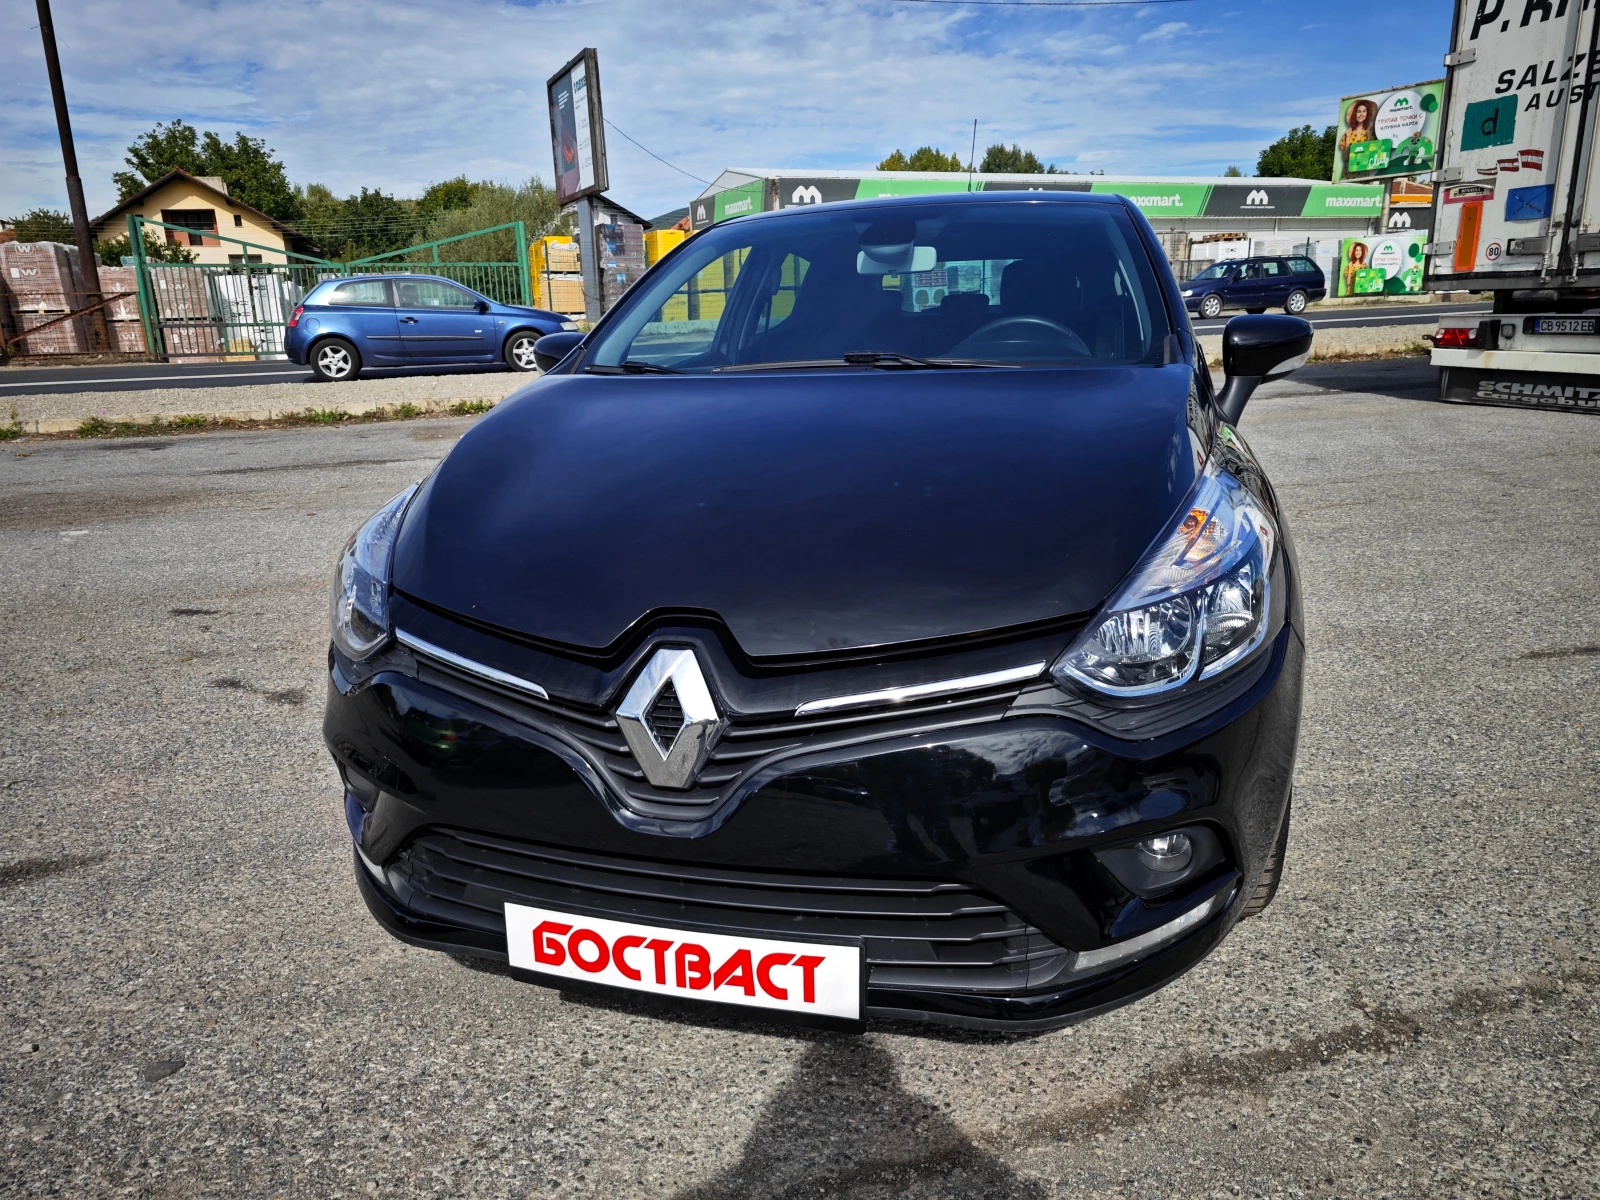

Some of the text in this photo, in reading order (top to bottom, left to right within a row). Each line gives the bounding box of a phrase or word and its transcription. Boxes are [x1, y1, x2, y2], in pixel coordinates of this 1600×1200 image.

[1481, 108, 1499, 136] d
[1129, 193, 1184, 207] axxmart.
[1488, 247, 1500, 257] 80
[1540, 321, 1595, 332] CB 9512 EB
[532, 920, 827, 1004] БОСТВАСТ
